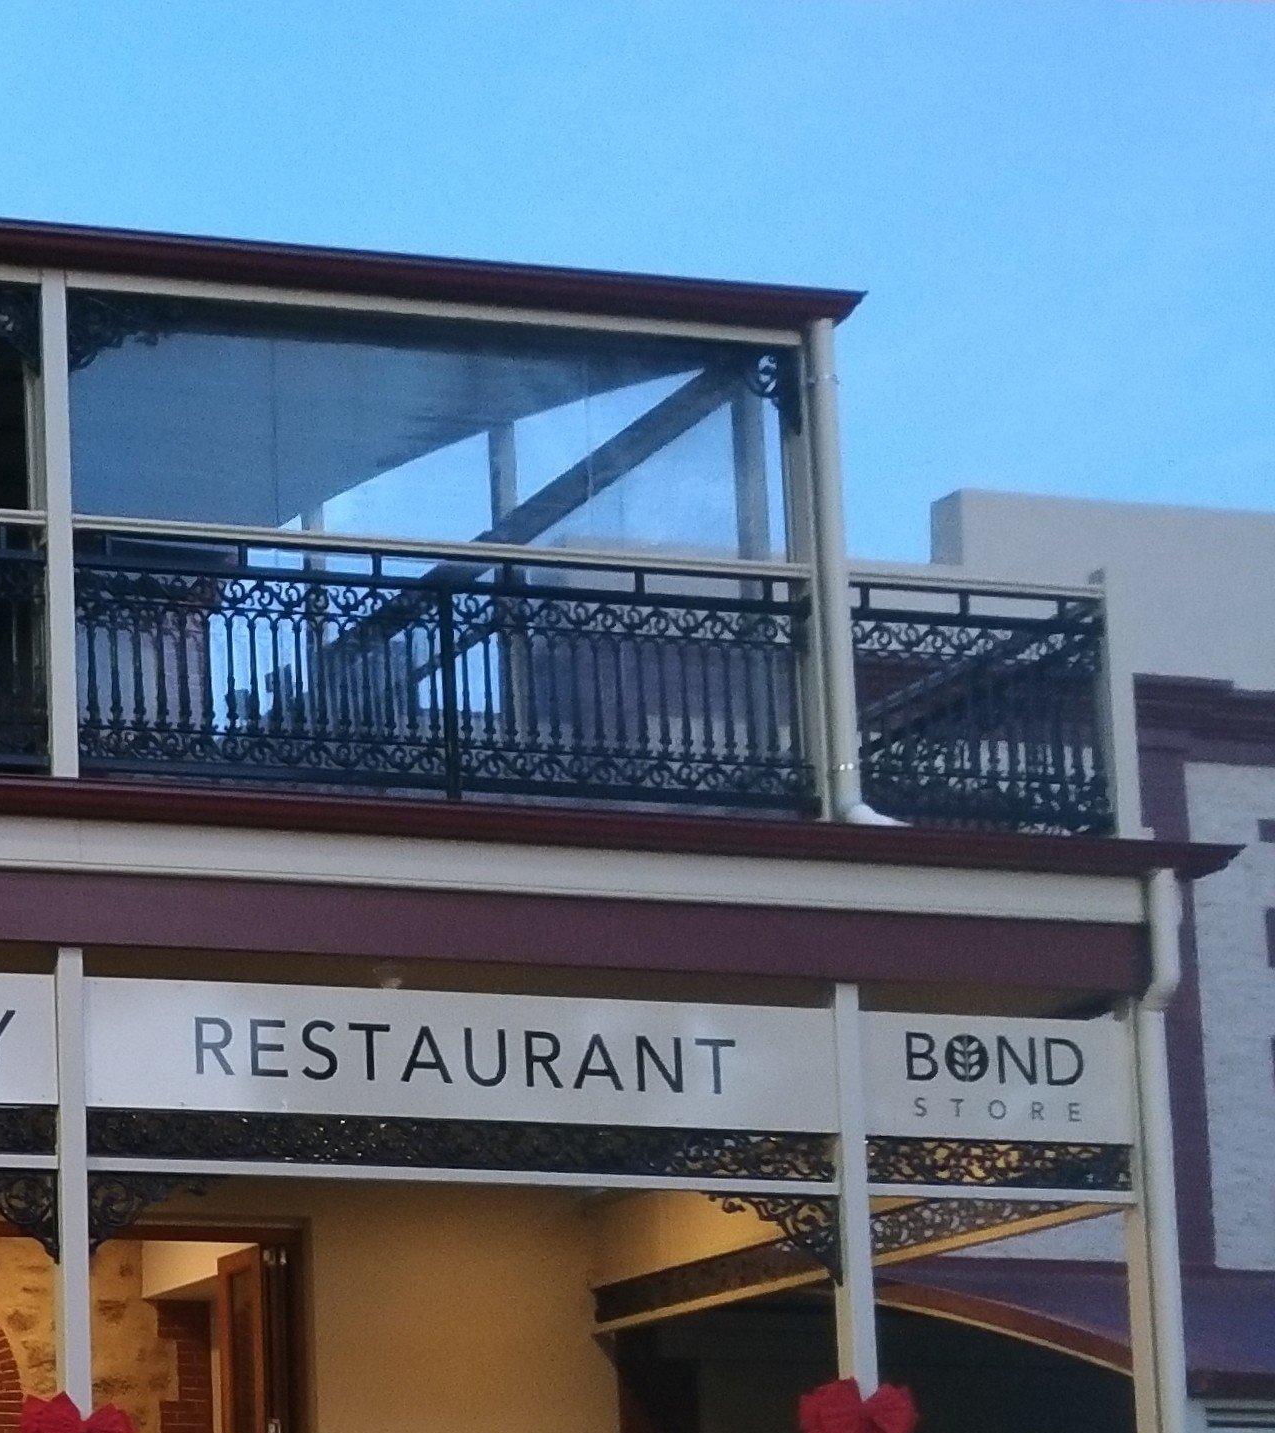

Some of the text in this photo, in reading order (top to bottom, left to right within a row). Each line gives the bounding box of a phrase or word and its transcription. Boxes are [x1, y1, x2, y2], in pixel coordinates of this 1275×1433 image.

[194, 1016, 736, 1095] RESTAURANT
[905, 1032, 1084, 1086] BOND
[913, 1097, 1082, 1122] STORE
